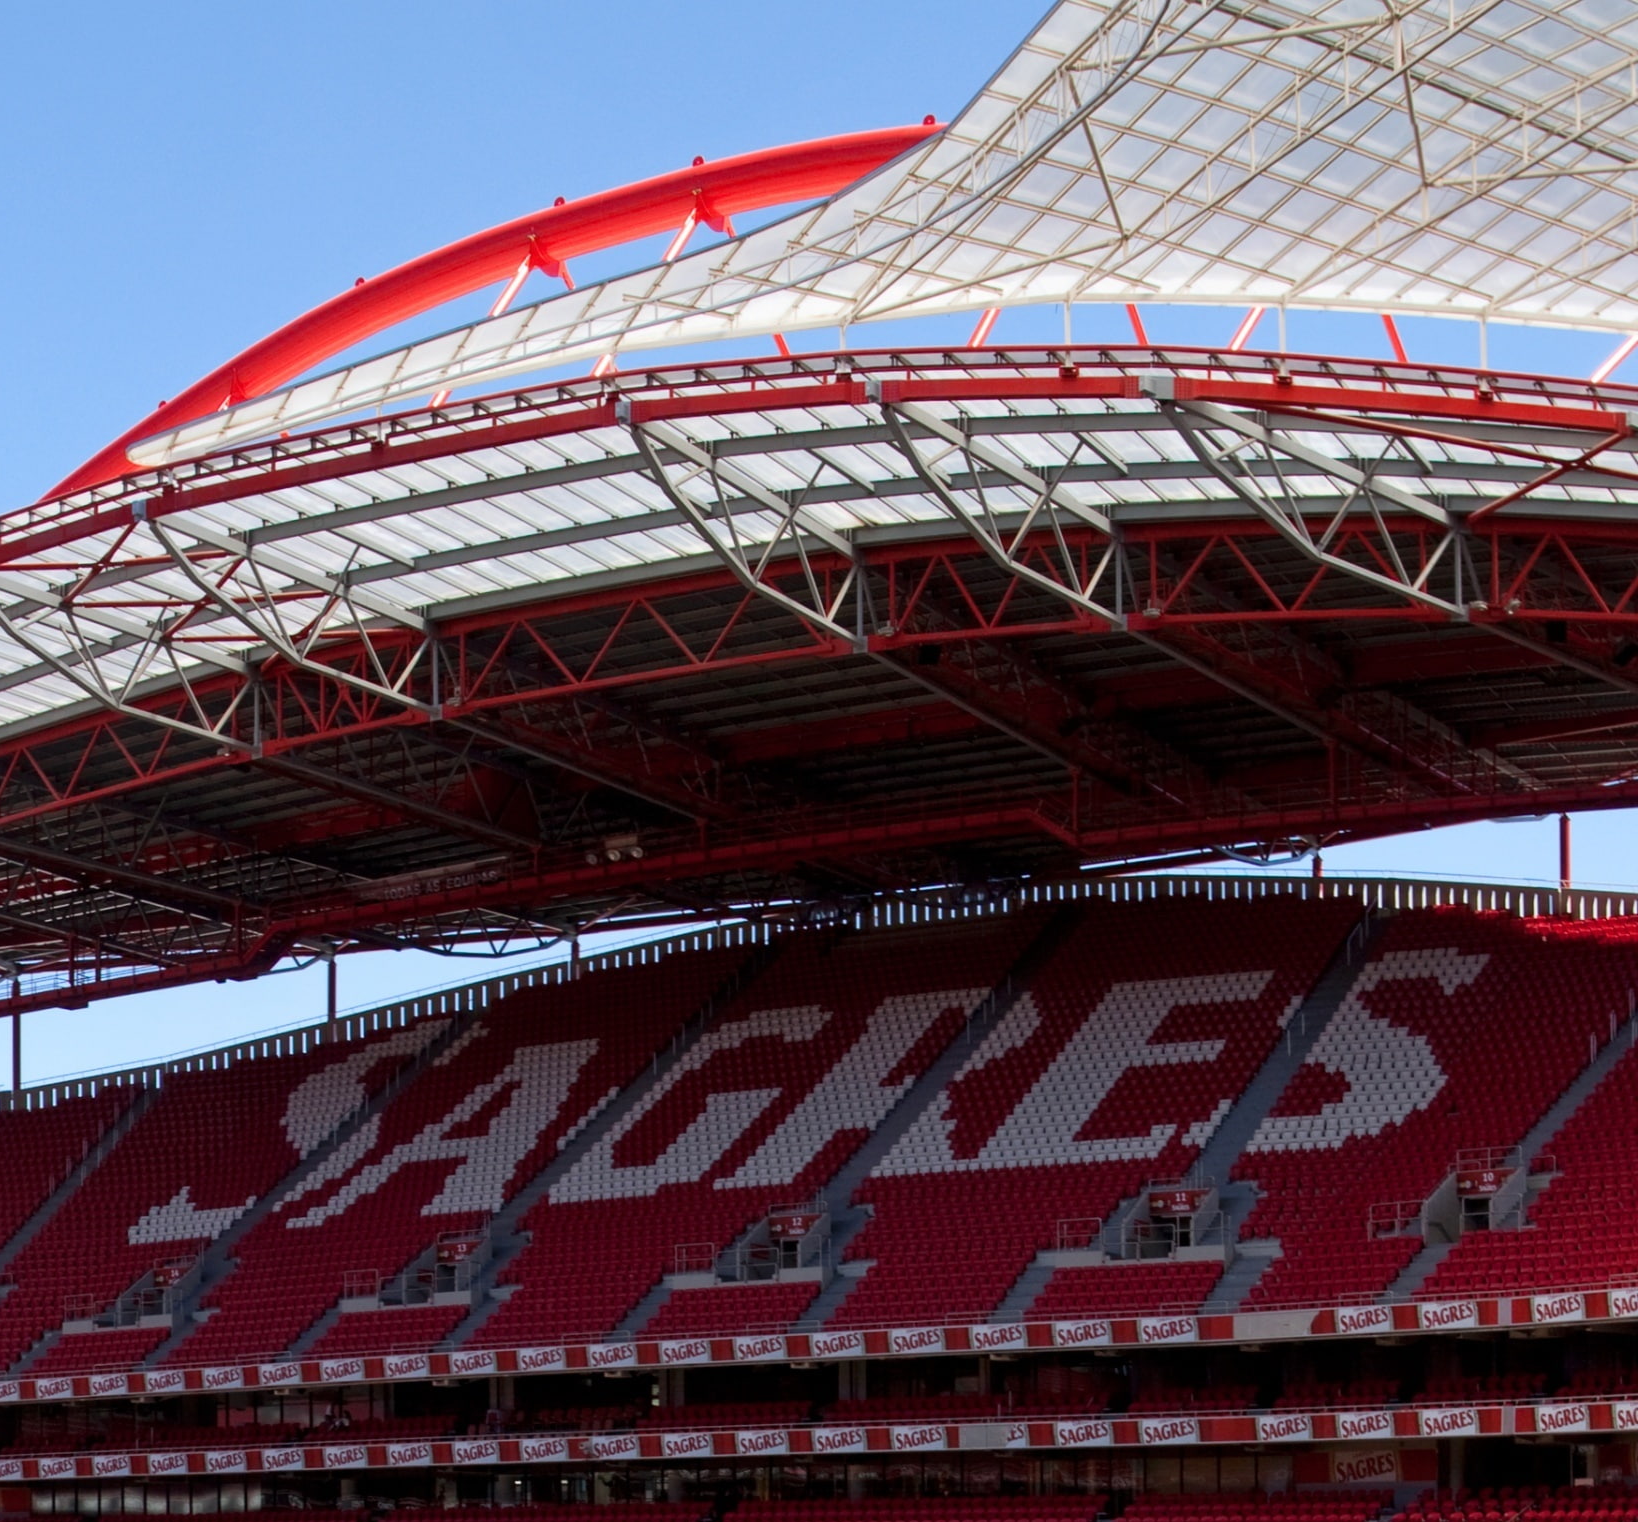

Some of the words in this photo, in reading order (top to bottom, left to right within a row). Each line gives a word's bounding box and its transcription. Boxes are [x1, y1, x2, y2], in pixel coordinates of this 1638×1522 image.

[1482, 1172, 1494, 1183] 10
[1058, 1321, 1107, 1346] SAGRES
[1425, 1410, 1473, 1435] SAGRES
[1335, 1453, 1395, 1482] SAGRES
